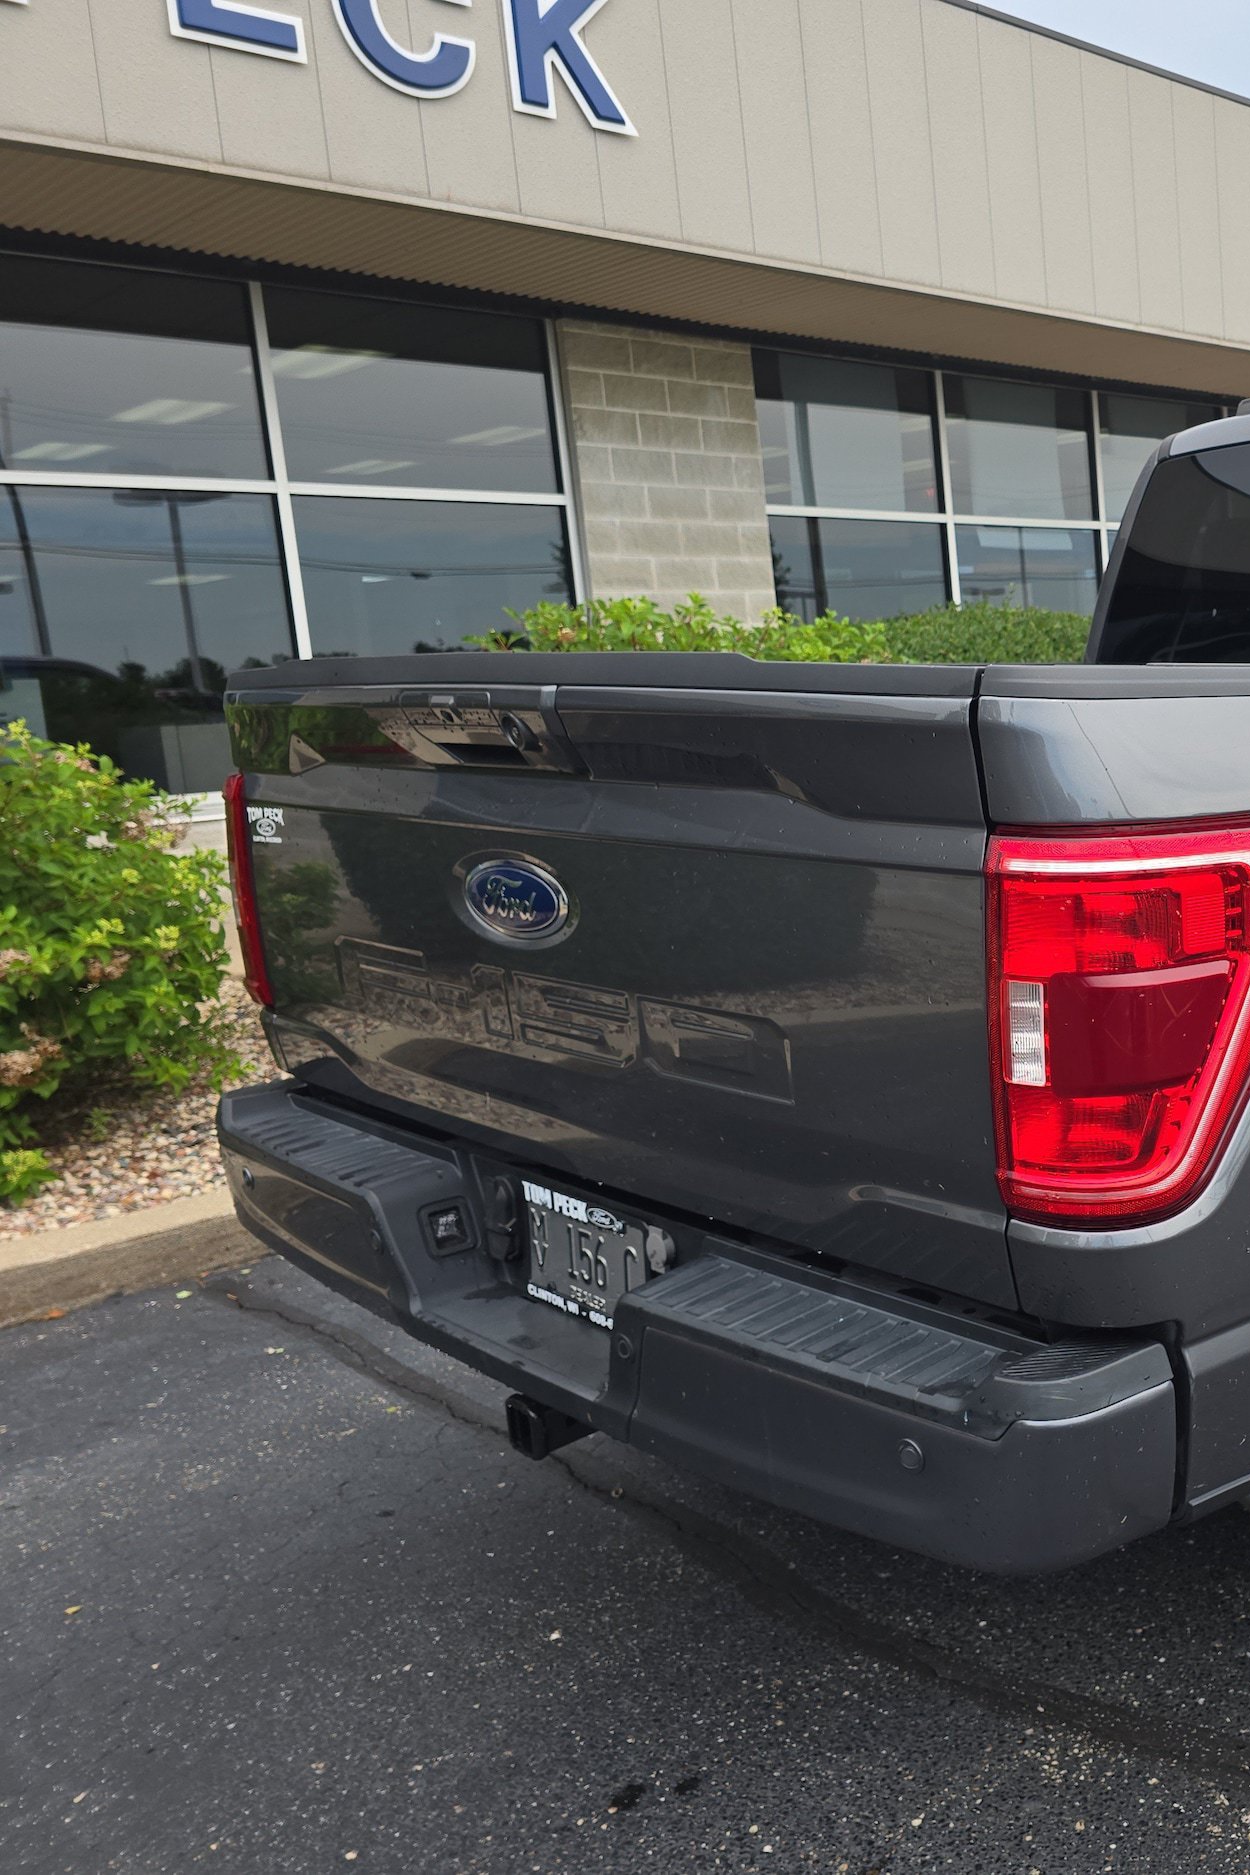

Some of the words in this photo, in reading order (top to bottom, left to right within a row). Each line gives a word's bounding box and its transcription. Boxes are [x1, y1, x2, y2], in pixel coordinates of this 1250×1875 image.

[482, 875, 538, 921] Ford
[335, 935, 795, 1106] F-150
[521, 1180, 552, 1210] TOM
[552, 1191, 589, 1224] PECK
[567, 1223, 609, 1287] 156
